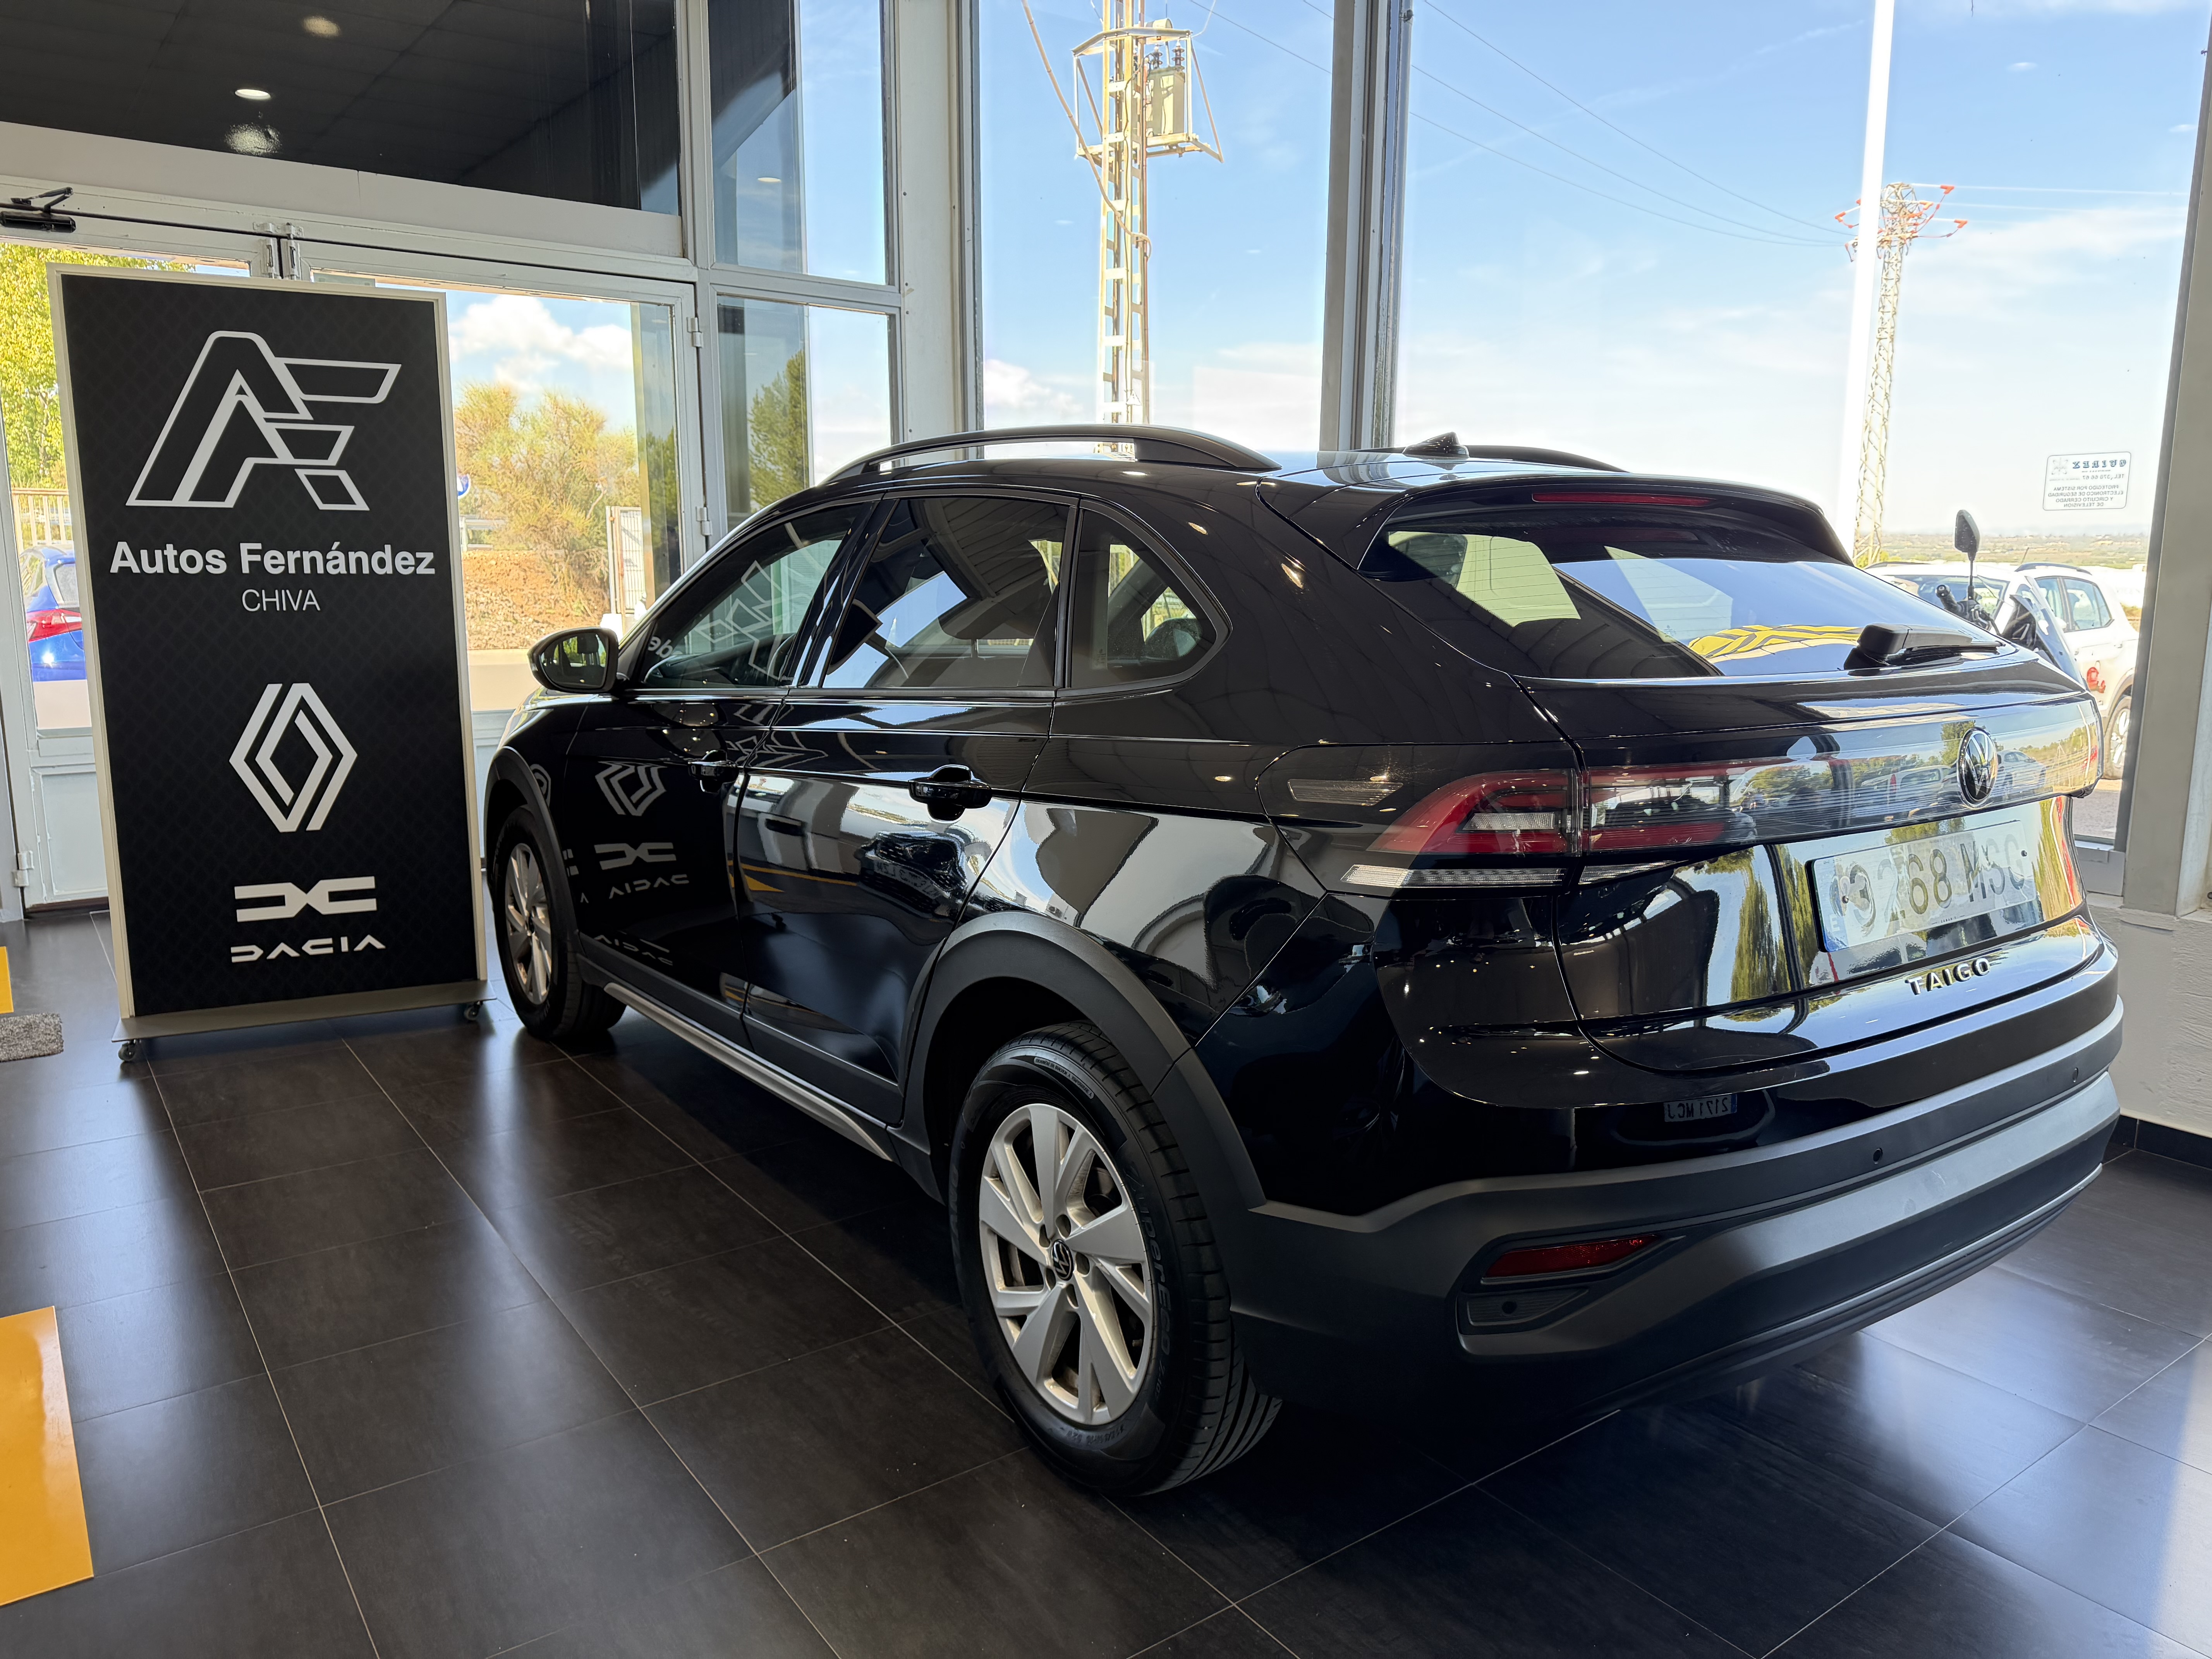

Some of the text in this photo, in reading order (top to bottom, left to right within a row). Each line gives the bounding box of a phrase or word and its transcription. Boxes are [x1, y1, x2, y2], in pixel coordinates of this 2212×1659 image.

[110, 541, 435, 575] Autos Fernández
[242, 589, 321, 612] CHIVA
[230, 934, 386, 963] DACIA
[1905, 957, 1991, 996] TAIGO
